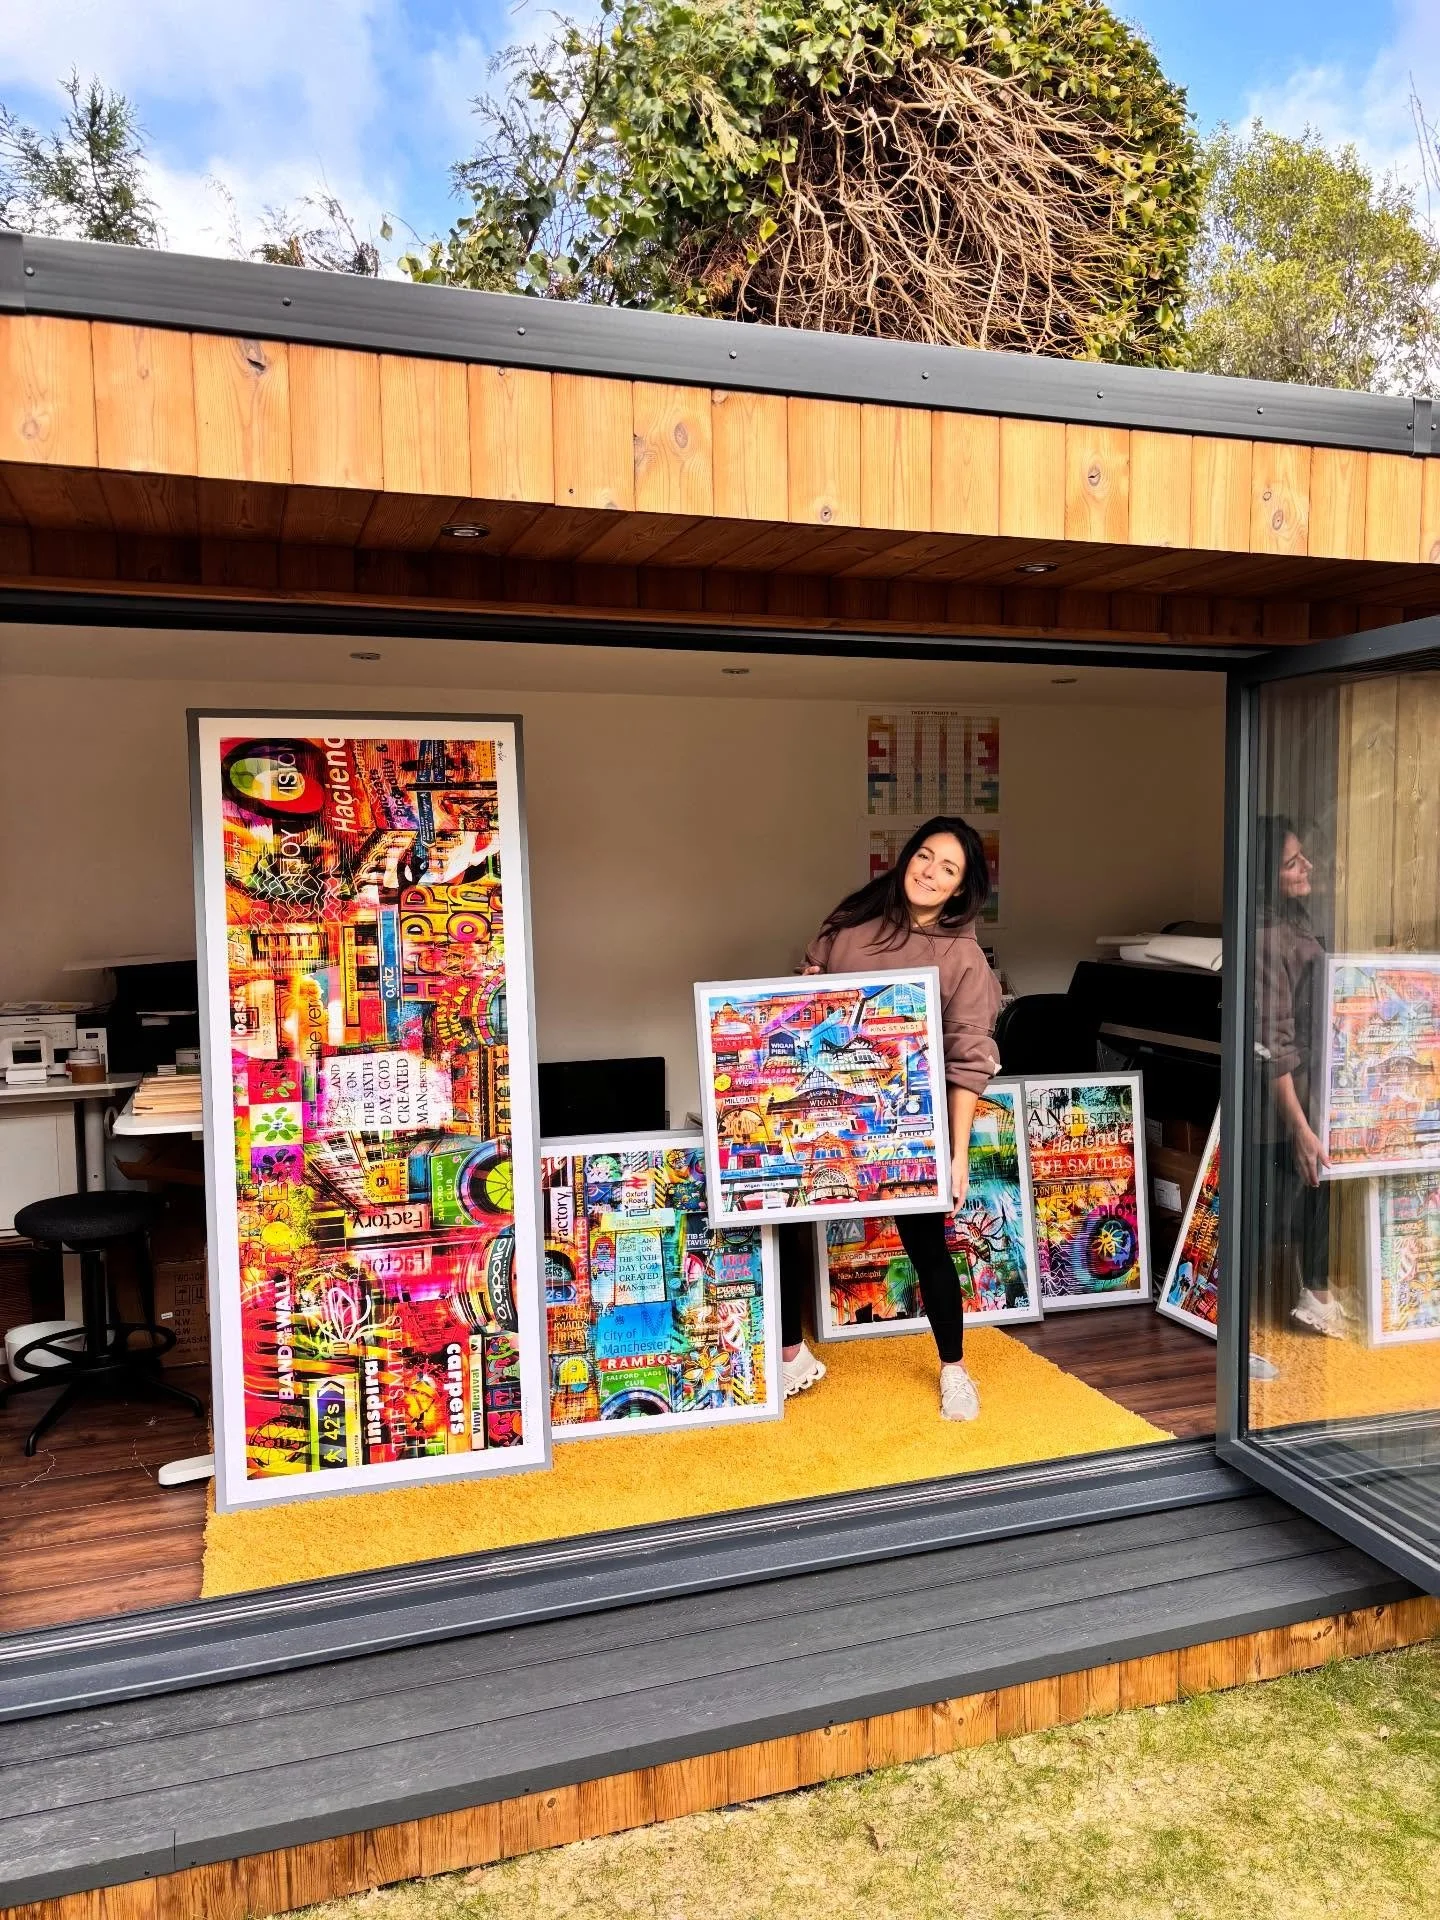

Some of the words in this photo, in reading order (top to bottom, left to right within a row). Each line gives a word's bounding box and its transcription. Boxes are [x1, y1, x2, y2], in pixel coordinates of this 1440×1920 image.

[233, 987, 247, 1035] oasis
[436, 990, 453, 1045] THIRSTY
[448, 985, 472, 1047] SCHOLAR
[347, 1071, 357, 1088] ON
[362, 1061, 374, 1098] SIXTH
[378, 1060, 390, 1090] GOD
[396, 1058, 410, 1124] CREATED
[364, 1101, 375, 1125] THE
[724, 1096, 757, 1104] MILLGATE
[809, 1098, 838, 1107] WIGAN
[436, 1161, 444, 1181] LADS
[1031, 1160, 1062, 1175] THE
[1068, 1155, 1132, 1172] SMITHS
[436, 1185, 445, 1221] SALFORD
[446, 1178, 454, 1200] CLUB
[576, 1193, 584, 1216] BAND
[352, 1210, 423, 1230] Factory
[555, 1192, 571, 1244] Factory
[577, 1218, 588, 1273] SMITHS
[491, 1237, 507, 1304] apollo
[274, 1274, 292, 1330] WALL
[603, 1341, 668, 1354] Manchester
[604, 1331, 623, 1341] City
[626, 1329, 637, 1339] of
[277, 1345, 295, 1400] BAND
[386, 1315, 405, 1400] SMITHS
[607, 1354, 677, 1370] RAMBOS
[443, 1343, 465, 1435] carpets
[323, 1403, 341, 1441] 42's
[389, 1409, 408, 1453] THE
